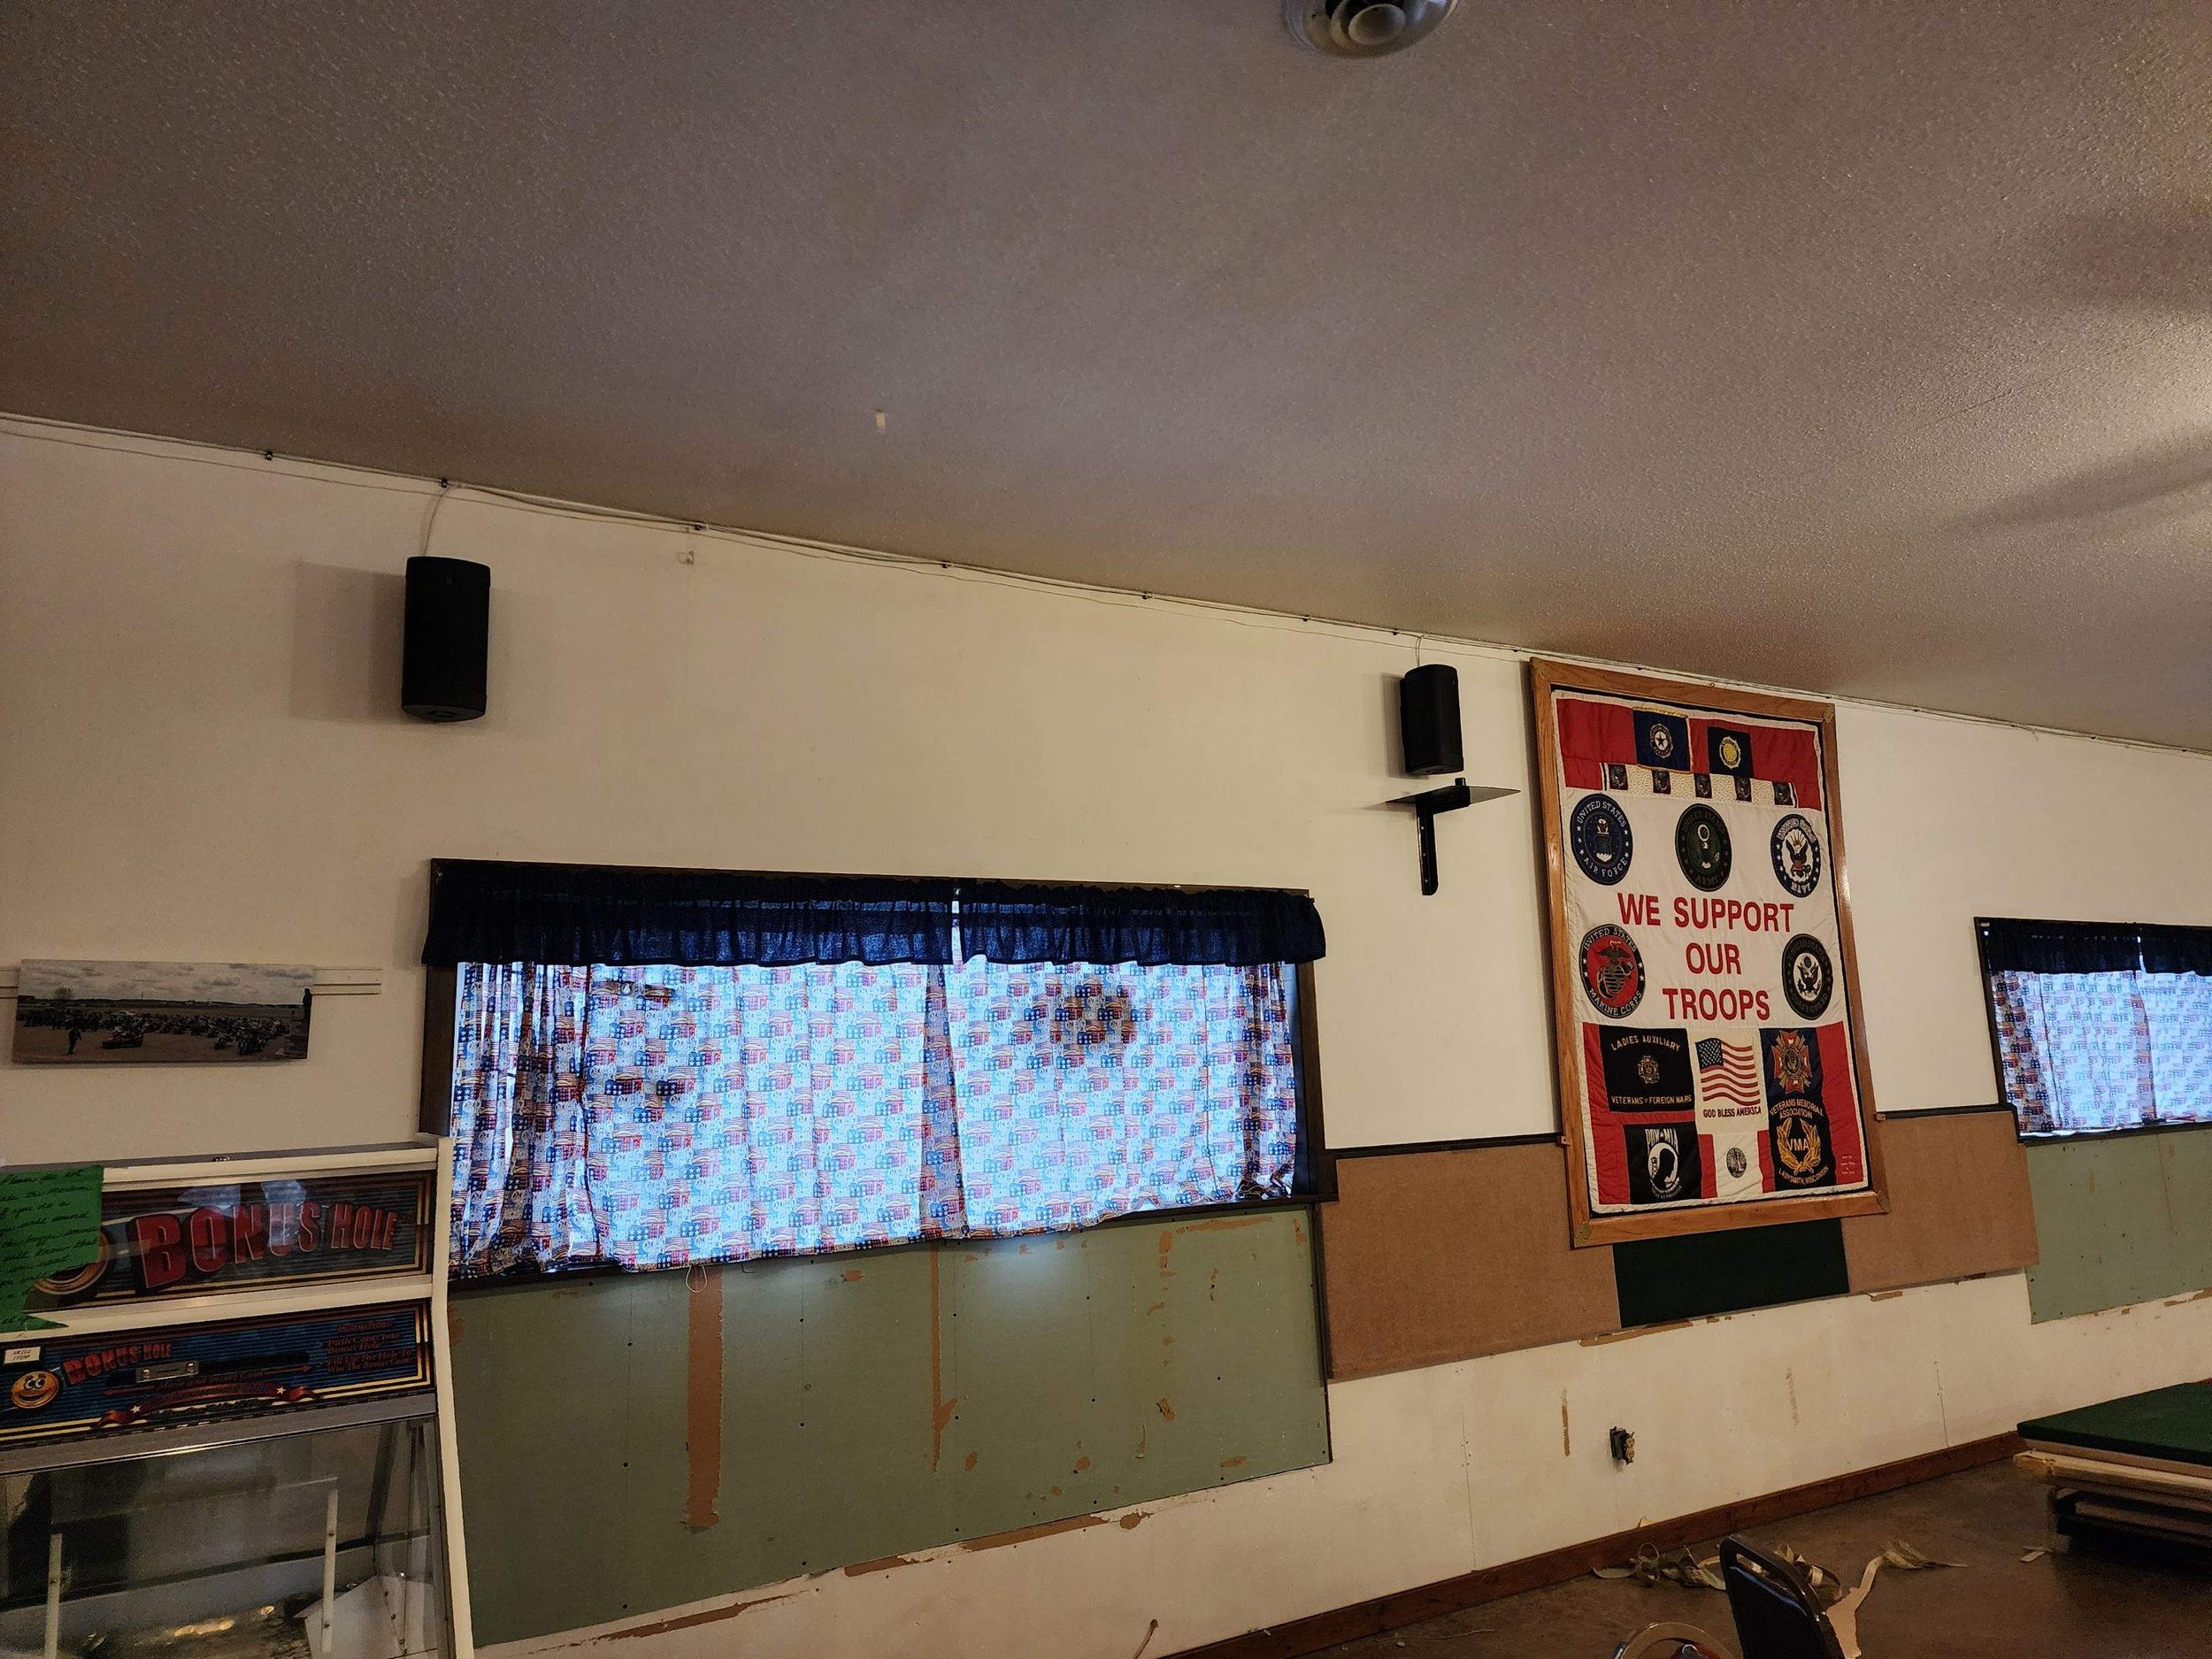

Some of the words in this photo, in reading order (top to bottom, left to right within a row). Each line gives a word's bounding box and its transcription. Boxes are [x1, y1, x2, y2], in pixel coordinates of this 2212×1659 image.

[1577, 800, 1601, 825] UNITED
[1602, 801, 1627, 828] STATES
[1584, 857, 1599, 875] AIR
[1601, 857, 1628, 878] FORCE
[1617, 892, 1661, 926] WE
[1674, 896, 1794, 933] SUPPORT
[1583, 928, 1610, 951] UNITED
[1613, 928, 1637, 952] STATES
[1686, 942, 1741, 975] OUR
[1589, 988, 1619, 1016] MARINE
[1620, 991, 1642, 1015] CORPS
[1663, 987, 1770, 1020] TROOPS
[1610, 1035, 1640, 1052] LADIES
[1642, 1035, 1681, 1053] AUXILIARY
[1610, 1095, 1644, 1105] VETERANS
[1648, 1095, 1676, 1105] FOREIGN
[1676, 1094, 1692, 1104] WARS
[1770, 1098, 1797, 1117] VETERANS
[1796, 1098, 1824, 1117] MEMORIAL
[1703, 1109, 1717, 1118] GOD
[1717, 1108, 1735, 1118] BLESS
[1736, 1106, 1762, 1117] AMERICA
[1779, 1108, 1813, 1120] ASSOCIATION
[1786, 1138, 1809, 1151] VMA
[1805, 1165, 1829, 1183] WISCONSIN
[133, 1200, 325, 1288] BONUS
[330, 1202, 398, 1250] HOLE
[62, 1346, 141, 1386] BONUS
[142, 1342, 172, 1360] HOLE
